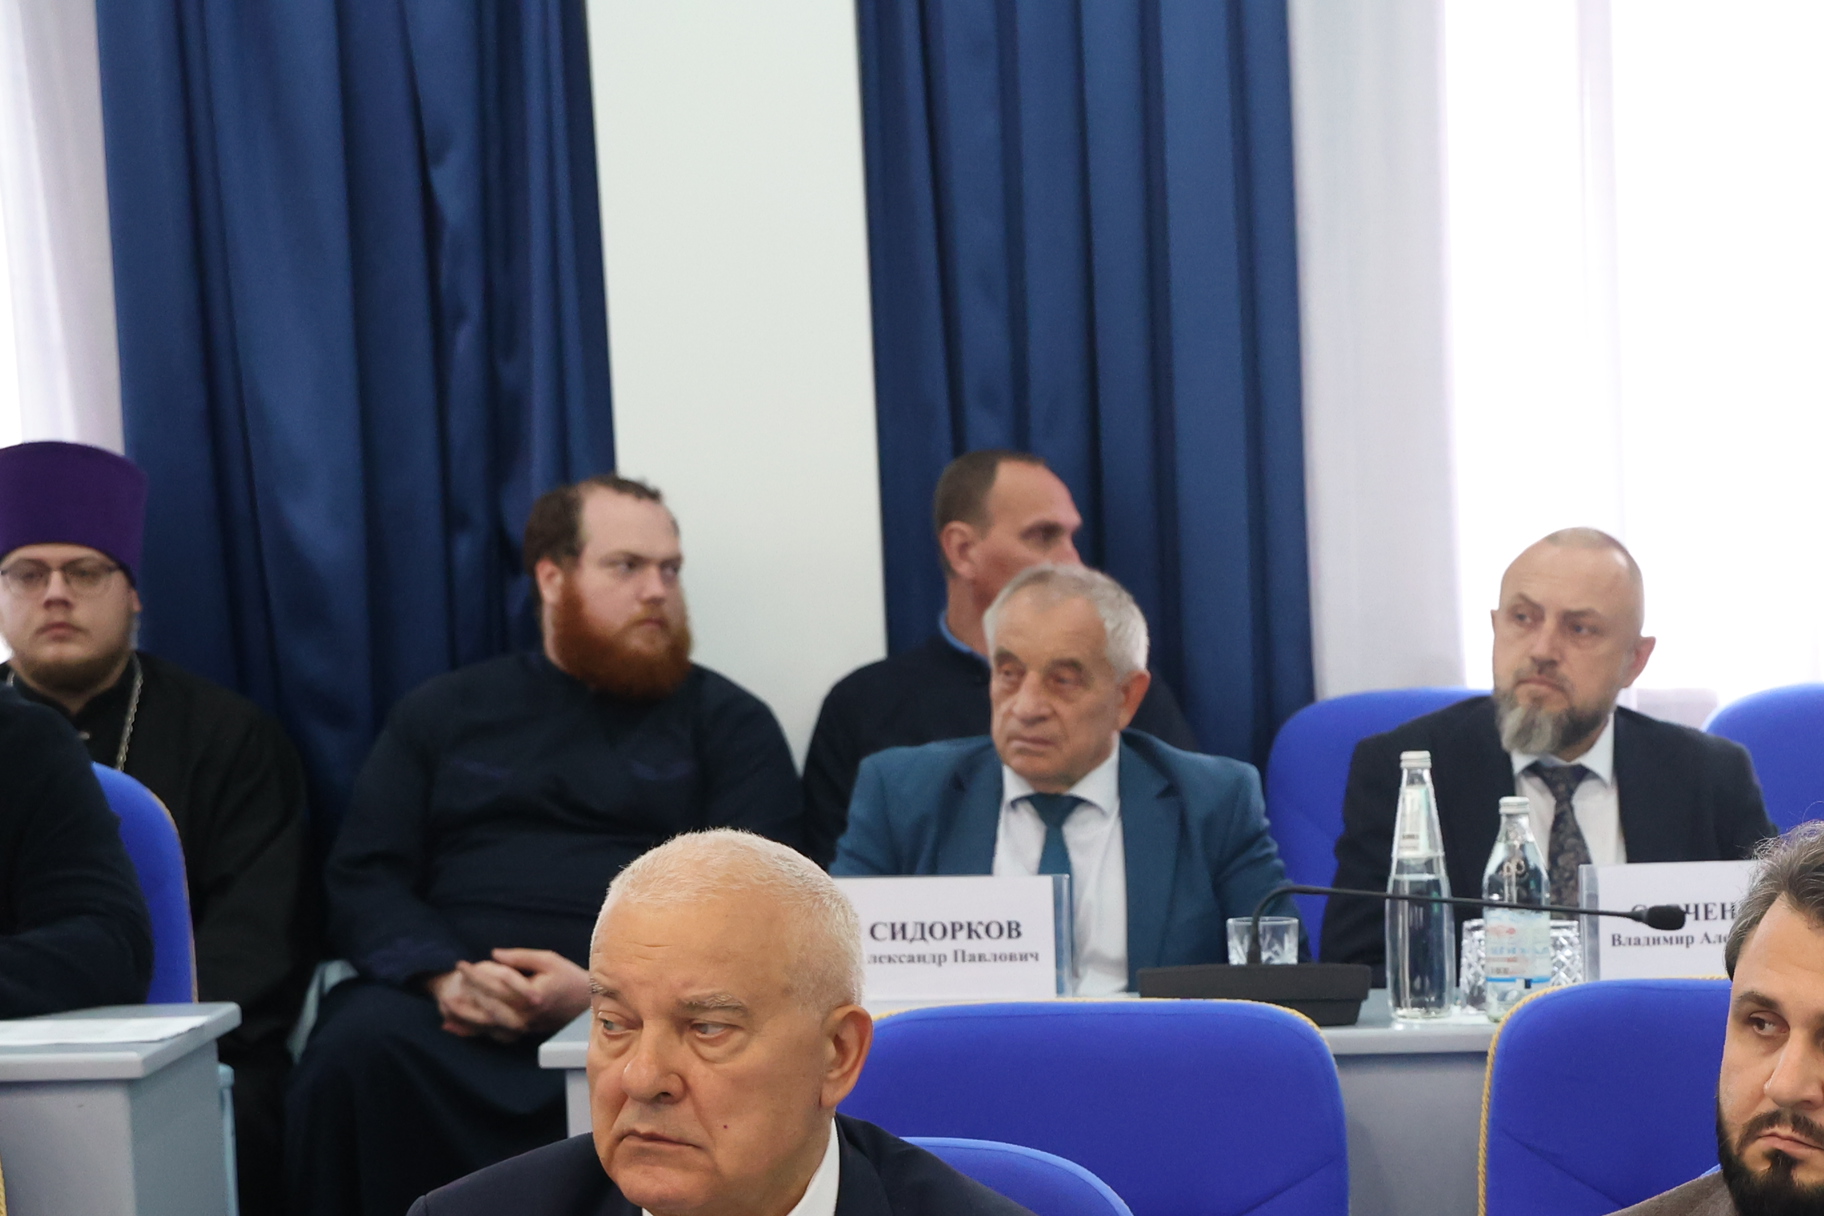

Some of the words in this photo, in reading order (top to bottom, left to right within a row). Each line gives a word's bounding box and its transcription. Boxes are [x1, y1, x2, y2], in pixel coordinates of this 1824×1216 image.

[869, 920, 1023, 944] СИДОРКОВ
[1611, 932, 1695, 949] Владимир
[867, 953, 948, 968] лександр
[953, 948, 1040, 964] Павлович
